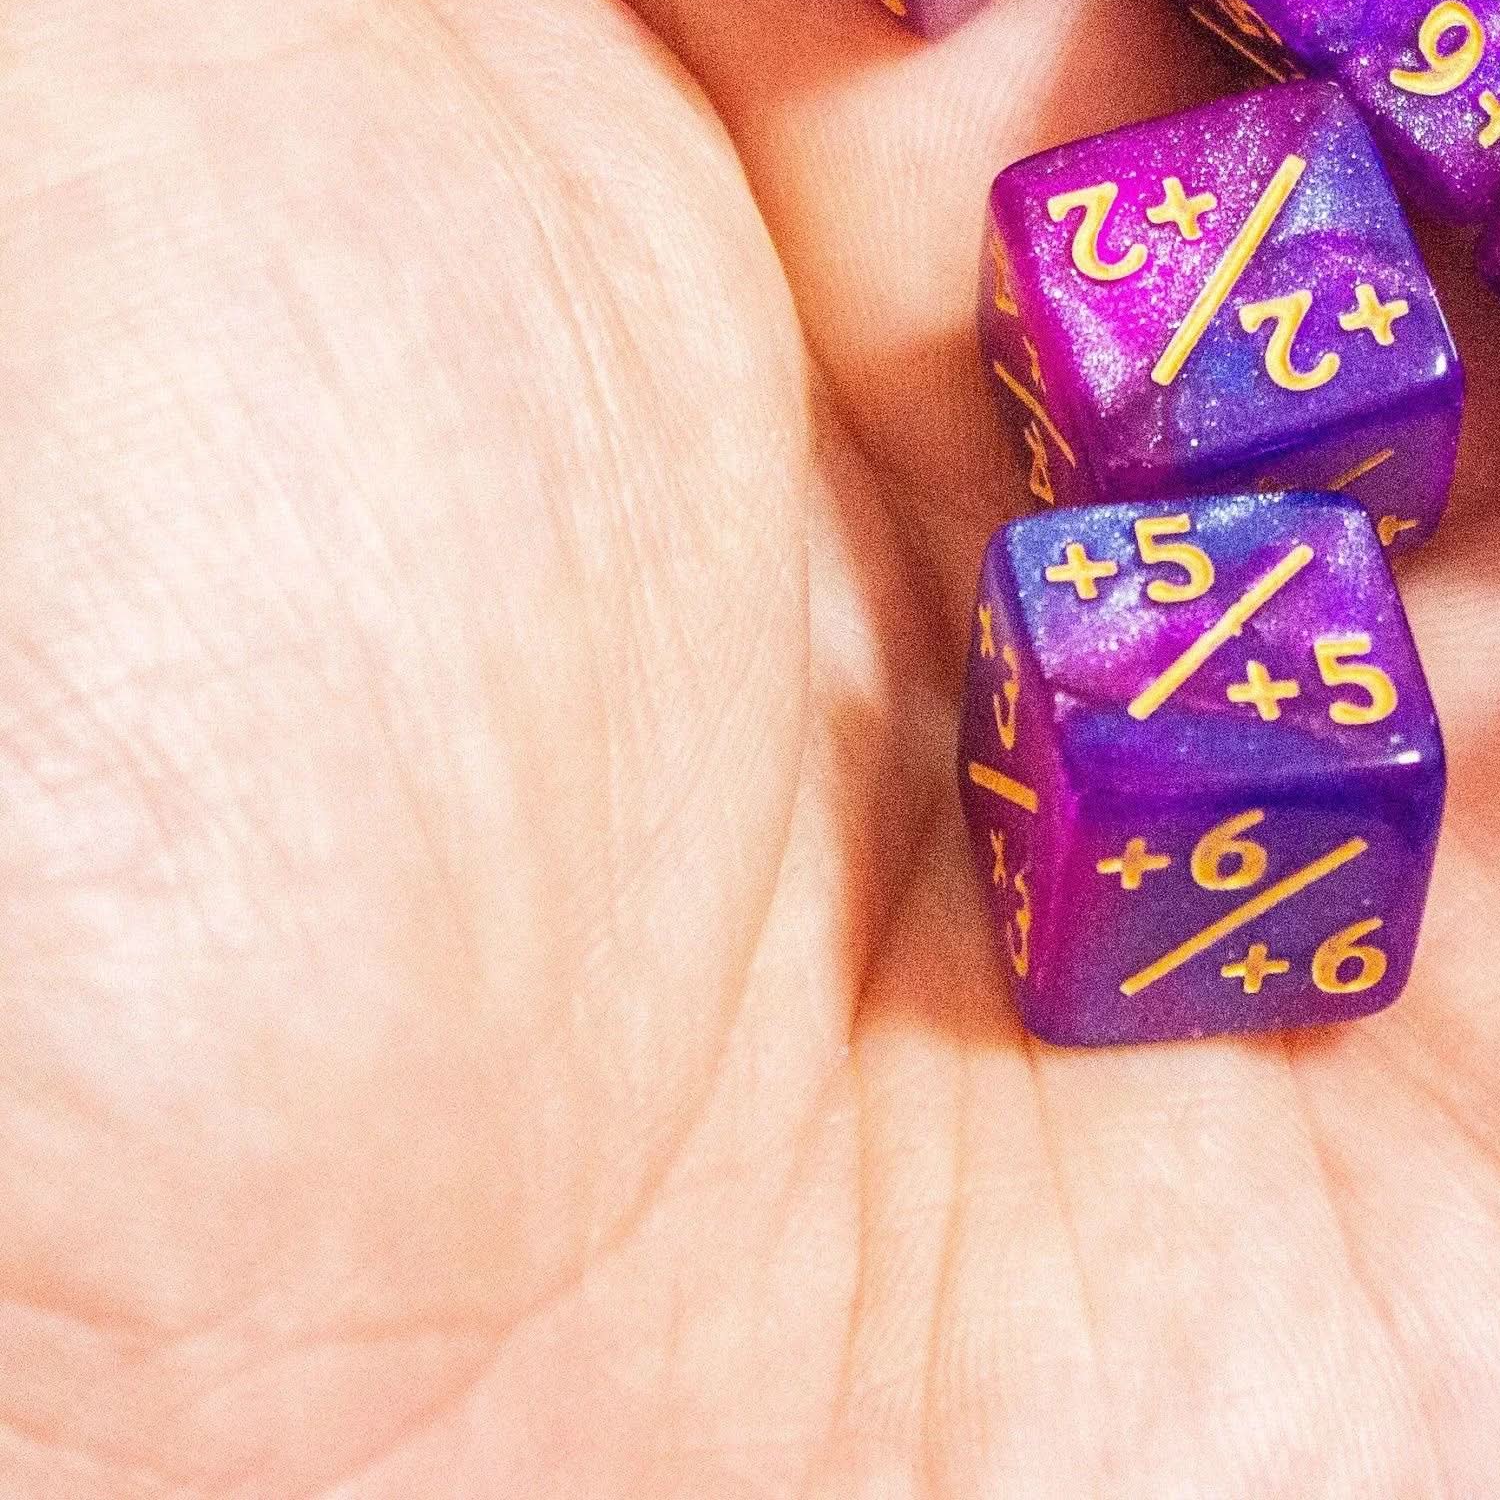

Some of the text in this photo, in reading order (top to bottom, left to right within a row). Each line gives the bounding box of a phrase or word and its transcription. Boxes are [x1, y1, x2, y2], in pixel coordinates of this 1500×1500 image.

[1046, 514, 1216, 605] +5
[1225, 635, 1399, 727] +5
[1096, 809, 1268, 893] +6
[1219, 917, 1389, 996] +6
